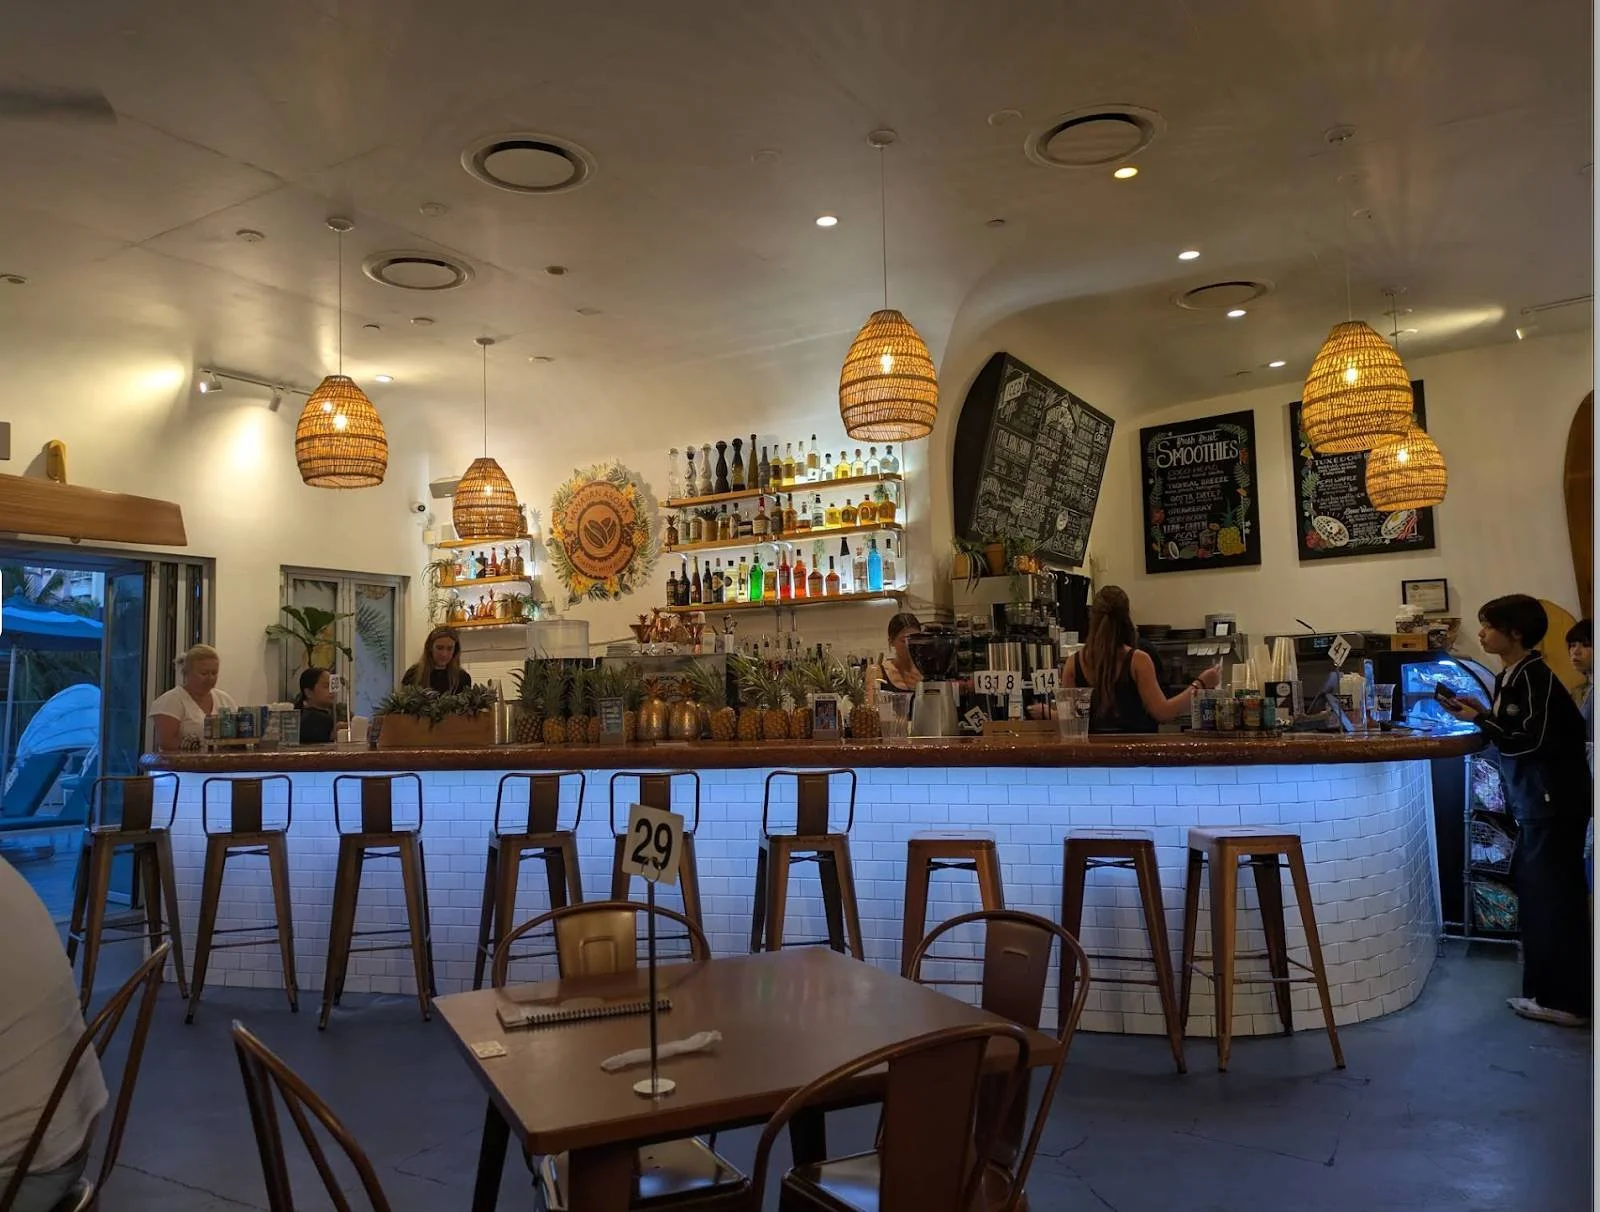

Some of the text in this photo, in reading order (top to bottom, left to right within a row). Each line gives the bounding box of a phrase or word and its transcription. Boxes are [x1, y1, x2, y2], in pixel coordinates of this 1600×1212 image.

[1156, 440, 1239, 468] SMOOTHIES
[1333, 642, 1348, 660] 41
[1006, 674, 1014, 690] 8
[1040, 673, 1055, 688] 14
[631, 818, 673, 870] 29
